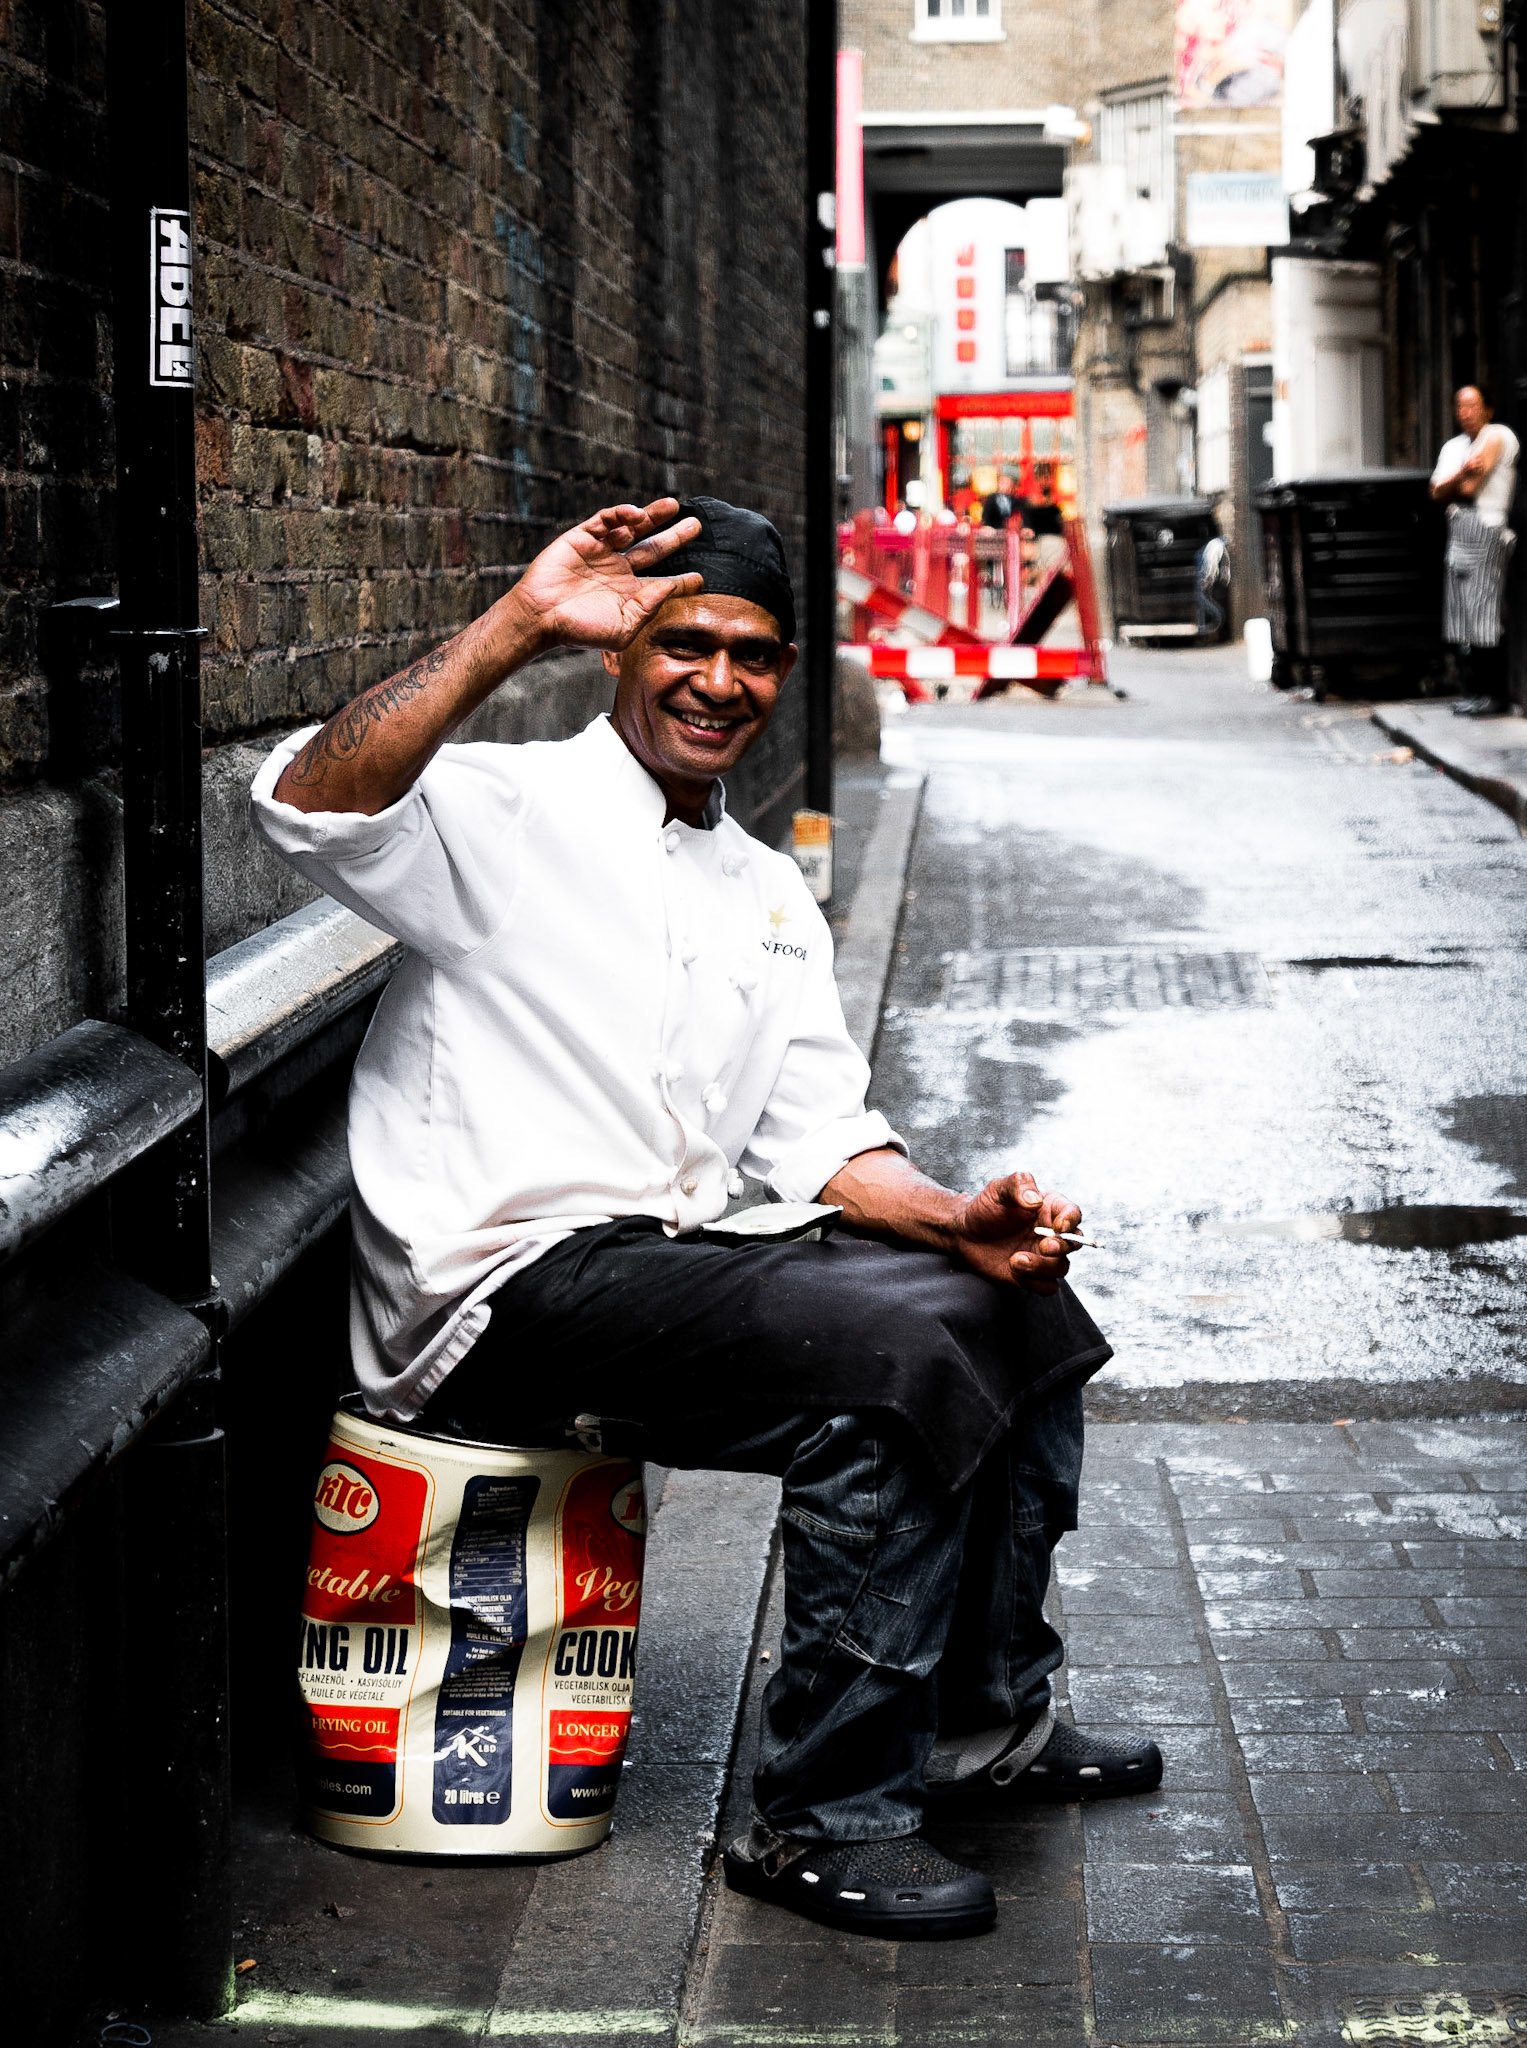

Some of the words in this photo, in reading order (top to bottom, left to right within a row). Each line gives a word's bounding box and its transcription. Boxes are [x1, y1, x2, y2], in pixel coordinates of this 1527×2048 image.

[363, 1626, 409, 1676] OIL
[554, 1629, 637, 1680] COOK
[310, 1687, 334, 1699] HUILE
[336, 1689, 347, 1700] DE
[554, 1680, 609, 1692] VEGETABILISK
[571, 1694, 627, 1706] VEGETABILISK
[364, 1720, 391, 1735] OIL
[557, 1723, 620, 1738] LONGER
[444, 1789, 458, 1805] 20
[459, 1789, 485, 1805] litres
